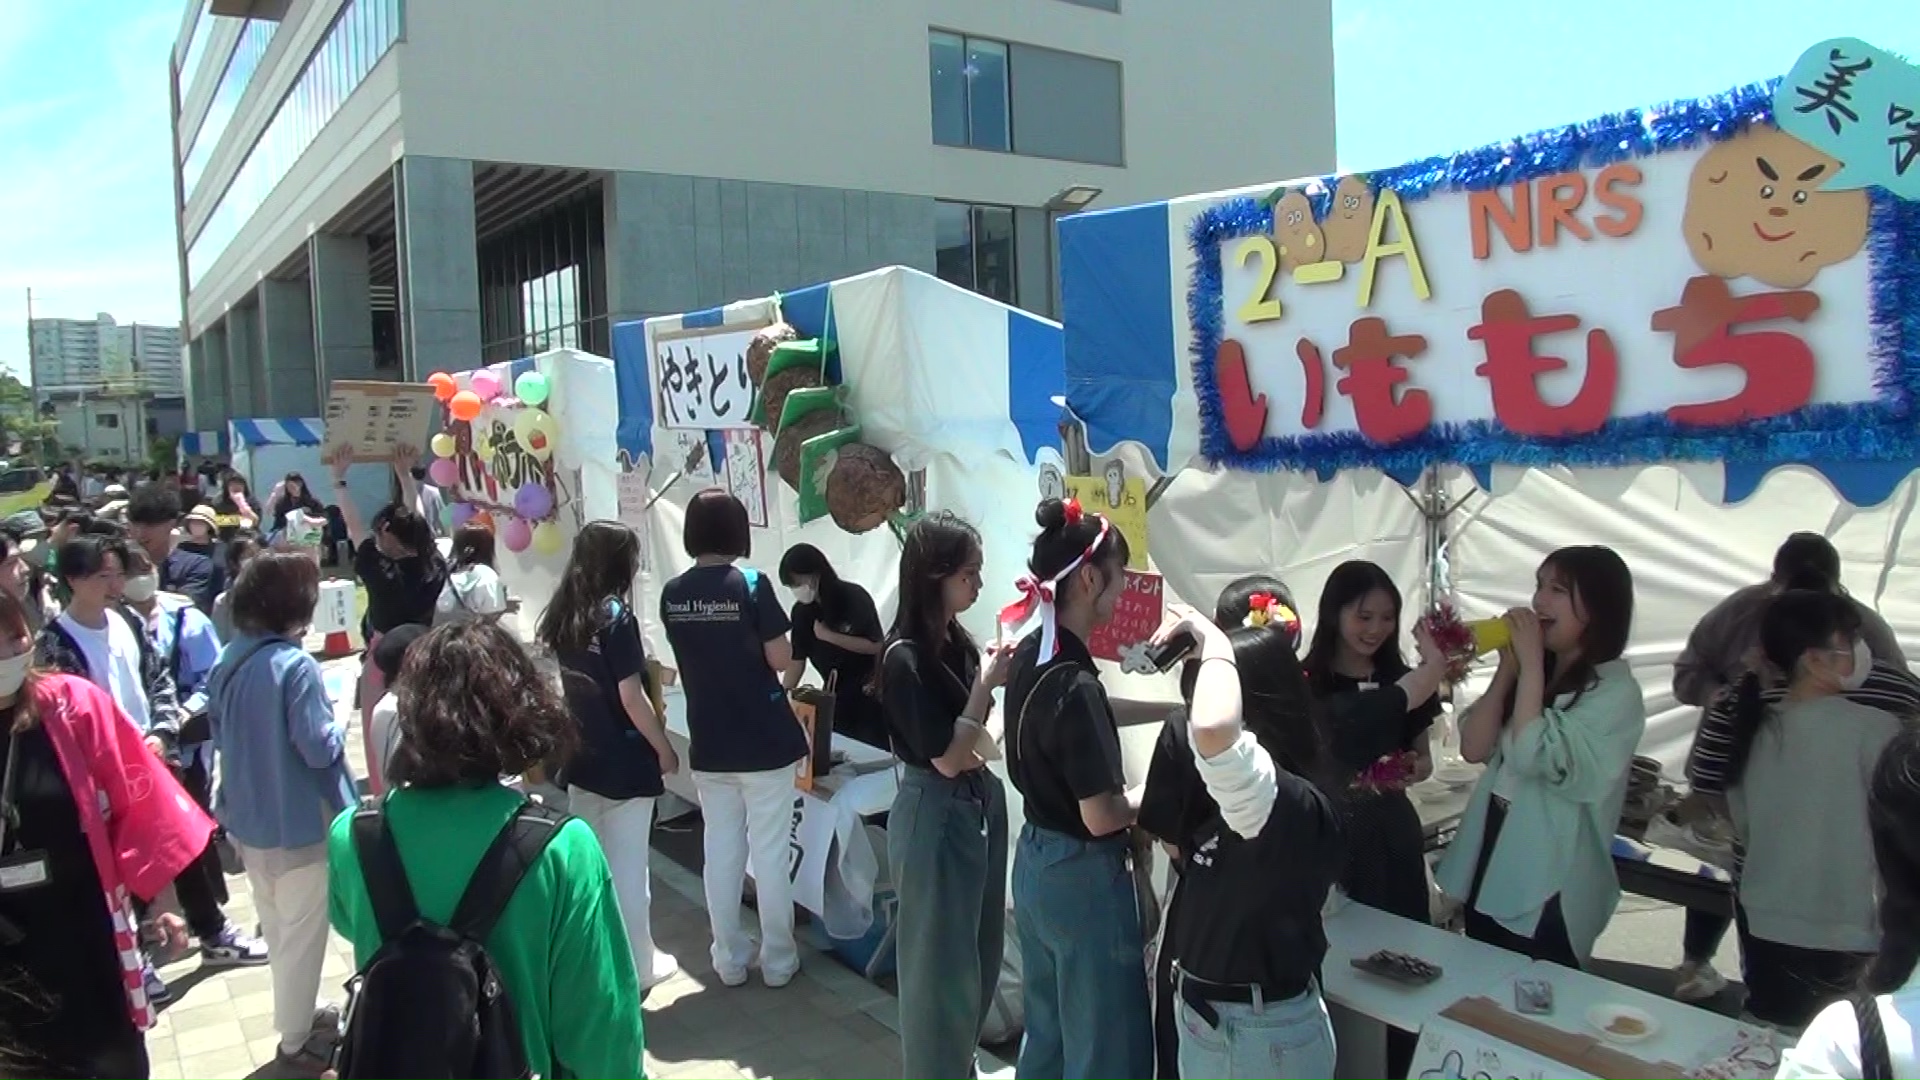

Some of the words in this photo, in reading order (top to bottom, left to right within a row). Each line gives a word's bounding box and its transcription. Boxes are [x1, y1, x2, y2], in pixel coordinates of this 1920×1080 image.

[1234, 189, 1430, 323] 2-A
[1468, 164, 1644, 260] NRS
[660, 345, 756, 428] やきとり
[1217, 273, 1821, 452] いももち
[692, 600, 739, 615] Hygienist
